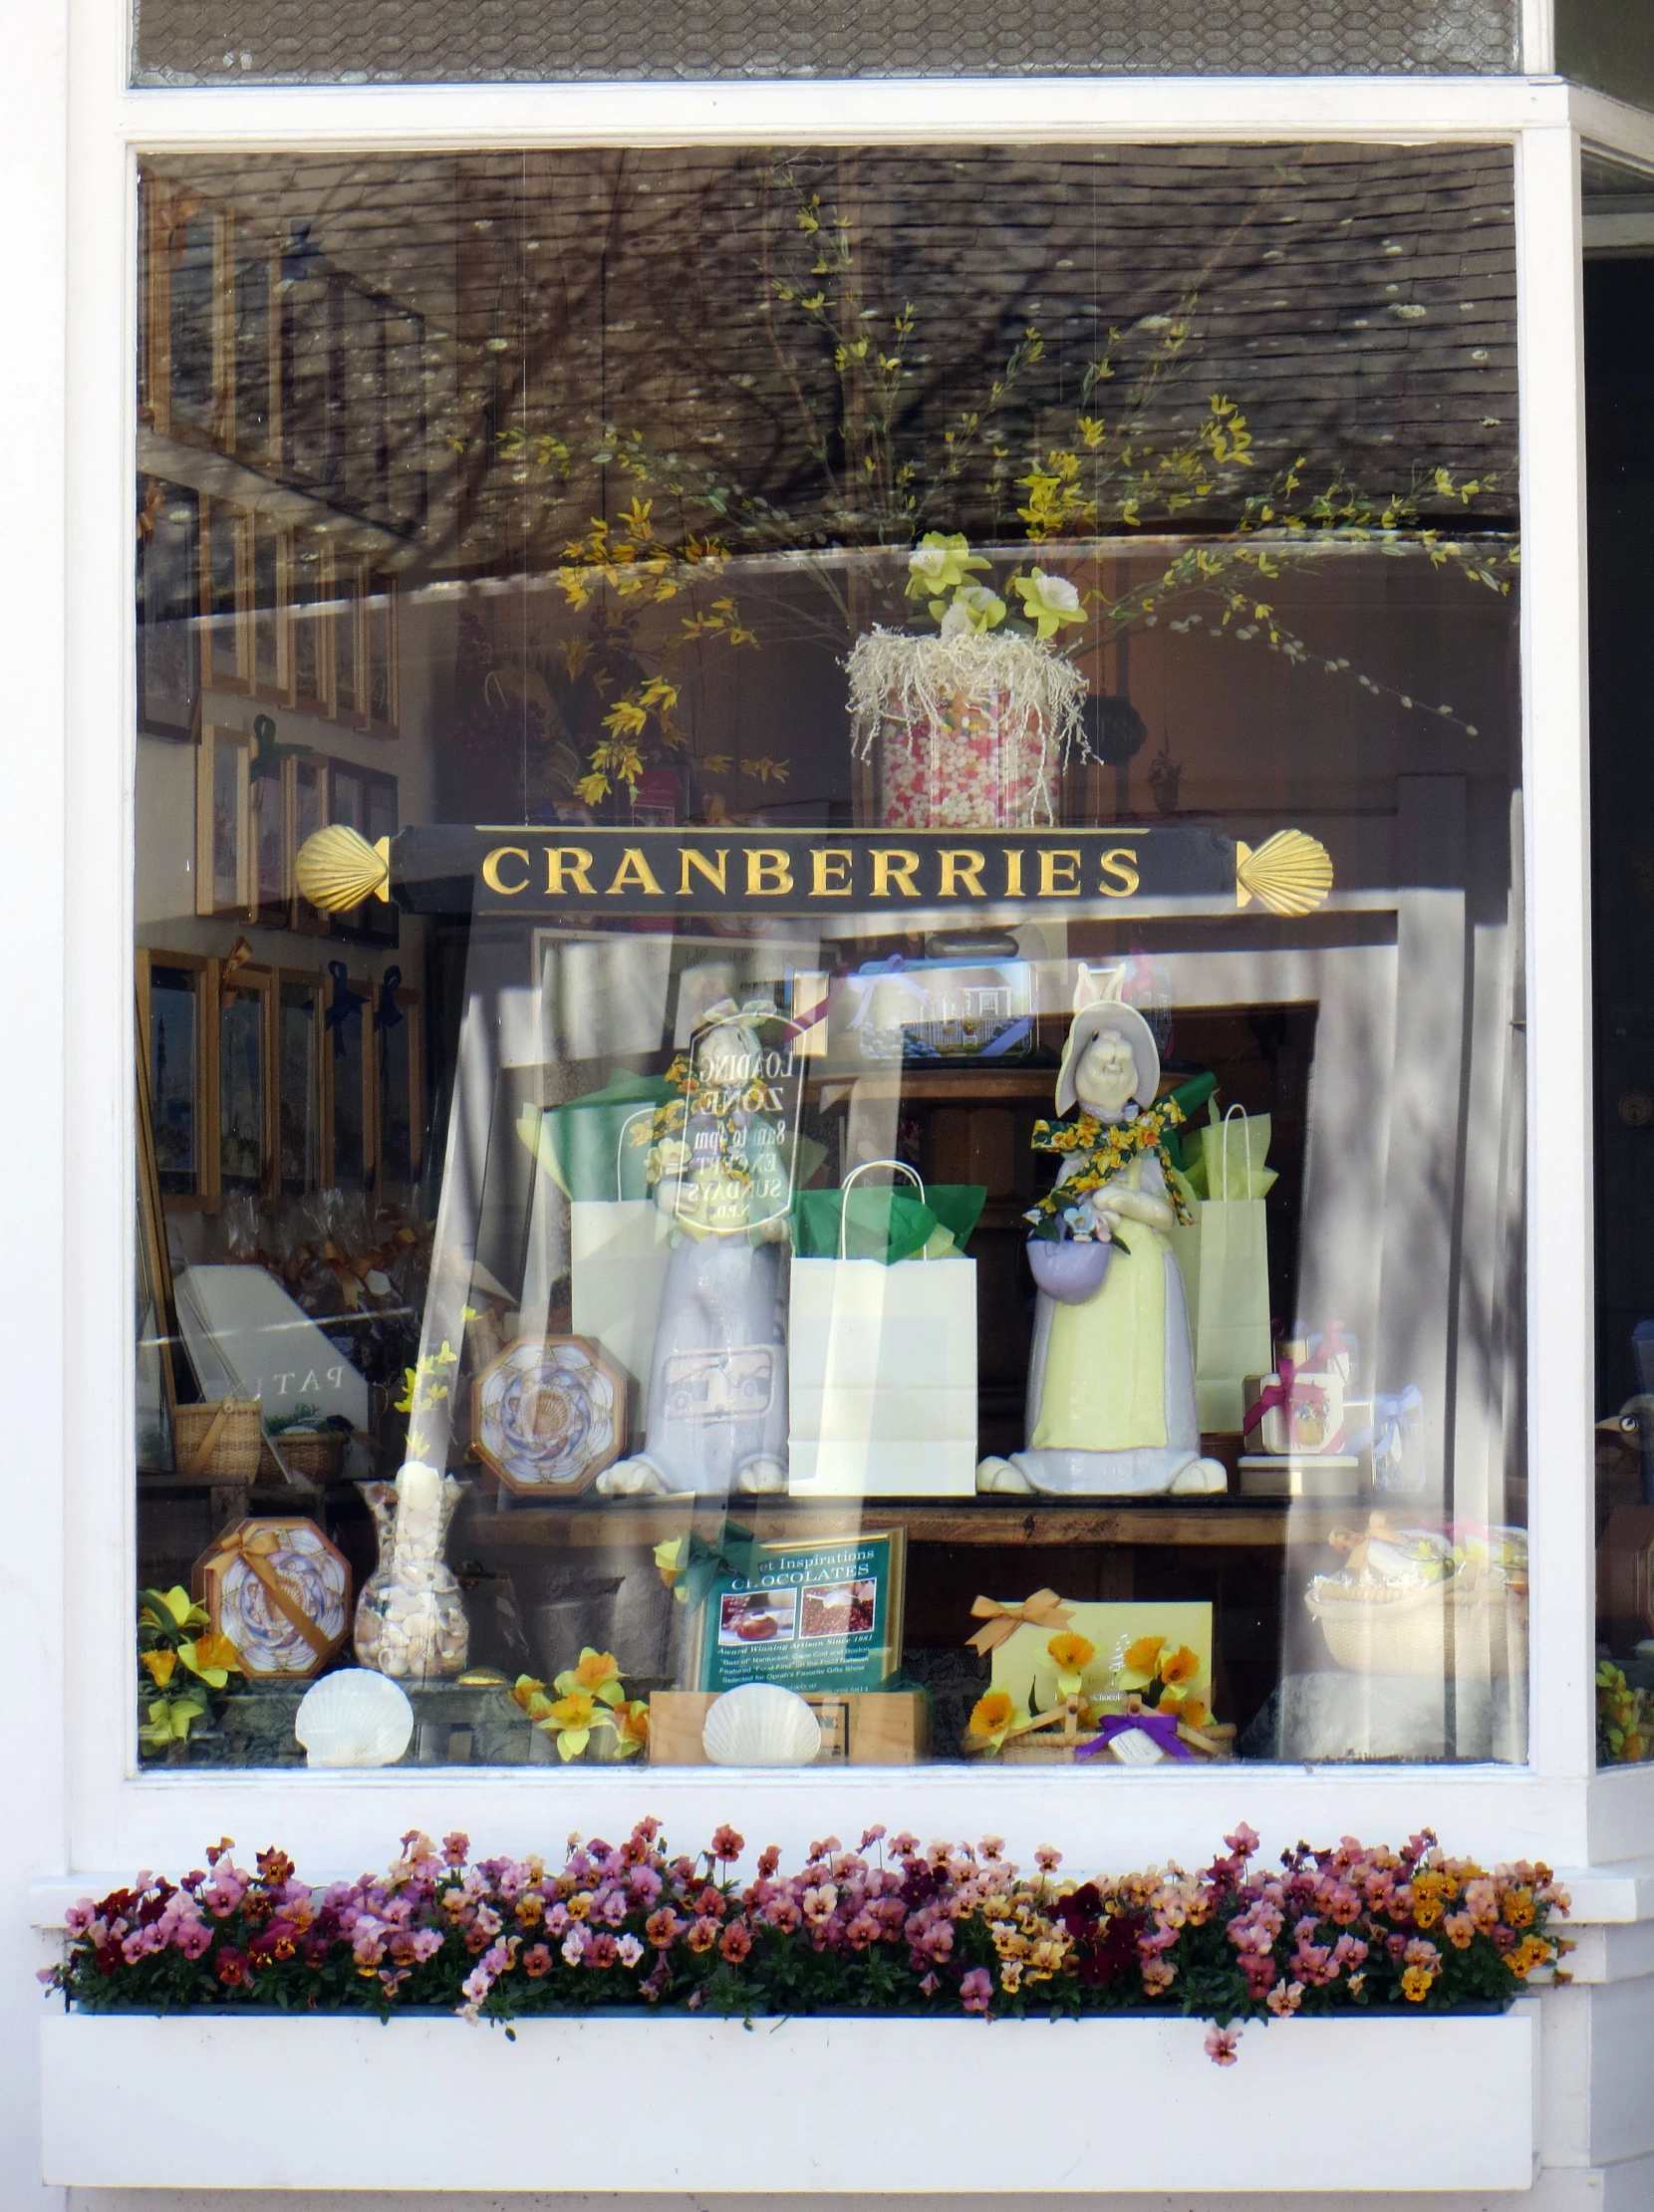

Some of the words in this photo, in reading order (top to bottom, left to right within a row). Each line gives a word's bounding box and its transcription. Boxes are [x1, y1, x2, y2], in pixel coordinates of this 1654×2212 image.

[481, 846, 1140, 897] CRANBERRIES
[780, 1549, 875, 1570] Inspirations
[717, 1646, 748, 1655] Award
[750, 1643, 788, 1653] Winning
[790, 1639, 824, 1649] Artisan
[826, 1637, 851, 1646] Since
[792, 1651, 811, 1661] Cape
[722, 1675, 753, 1684] Selected
[796, 1668, 825, 1678] Favorite
